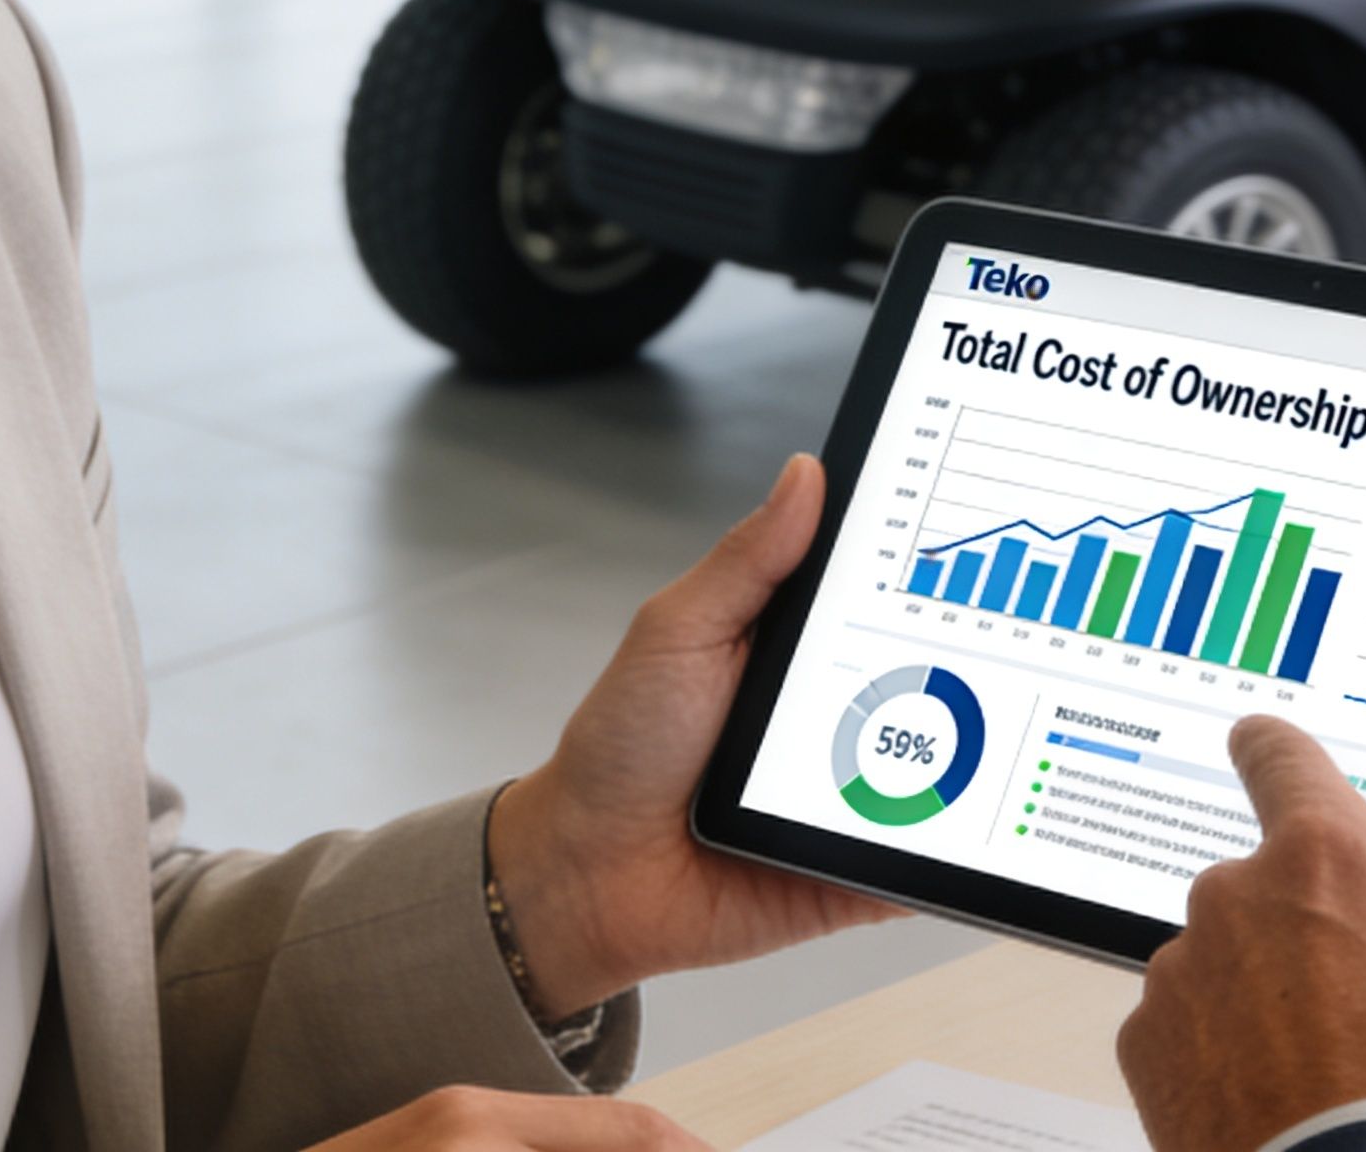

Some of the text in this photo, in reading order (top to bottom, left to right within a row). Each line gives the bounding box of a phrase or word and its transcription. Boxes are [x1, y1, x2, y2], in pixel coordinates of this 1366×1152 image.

[967, 256, 1050, 301] Teko
[941, 321, 1027, 374] Total
[1033, 338, 1117, 391] Cost
[1123, 357, 1169, 399] of
[875, 725, 936, 764] 59%
